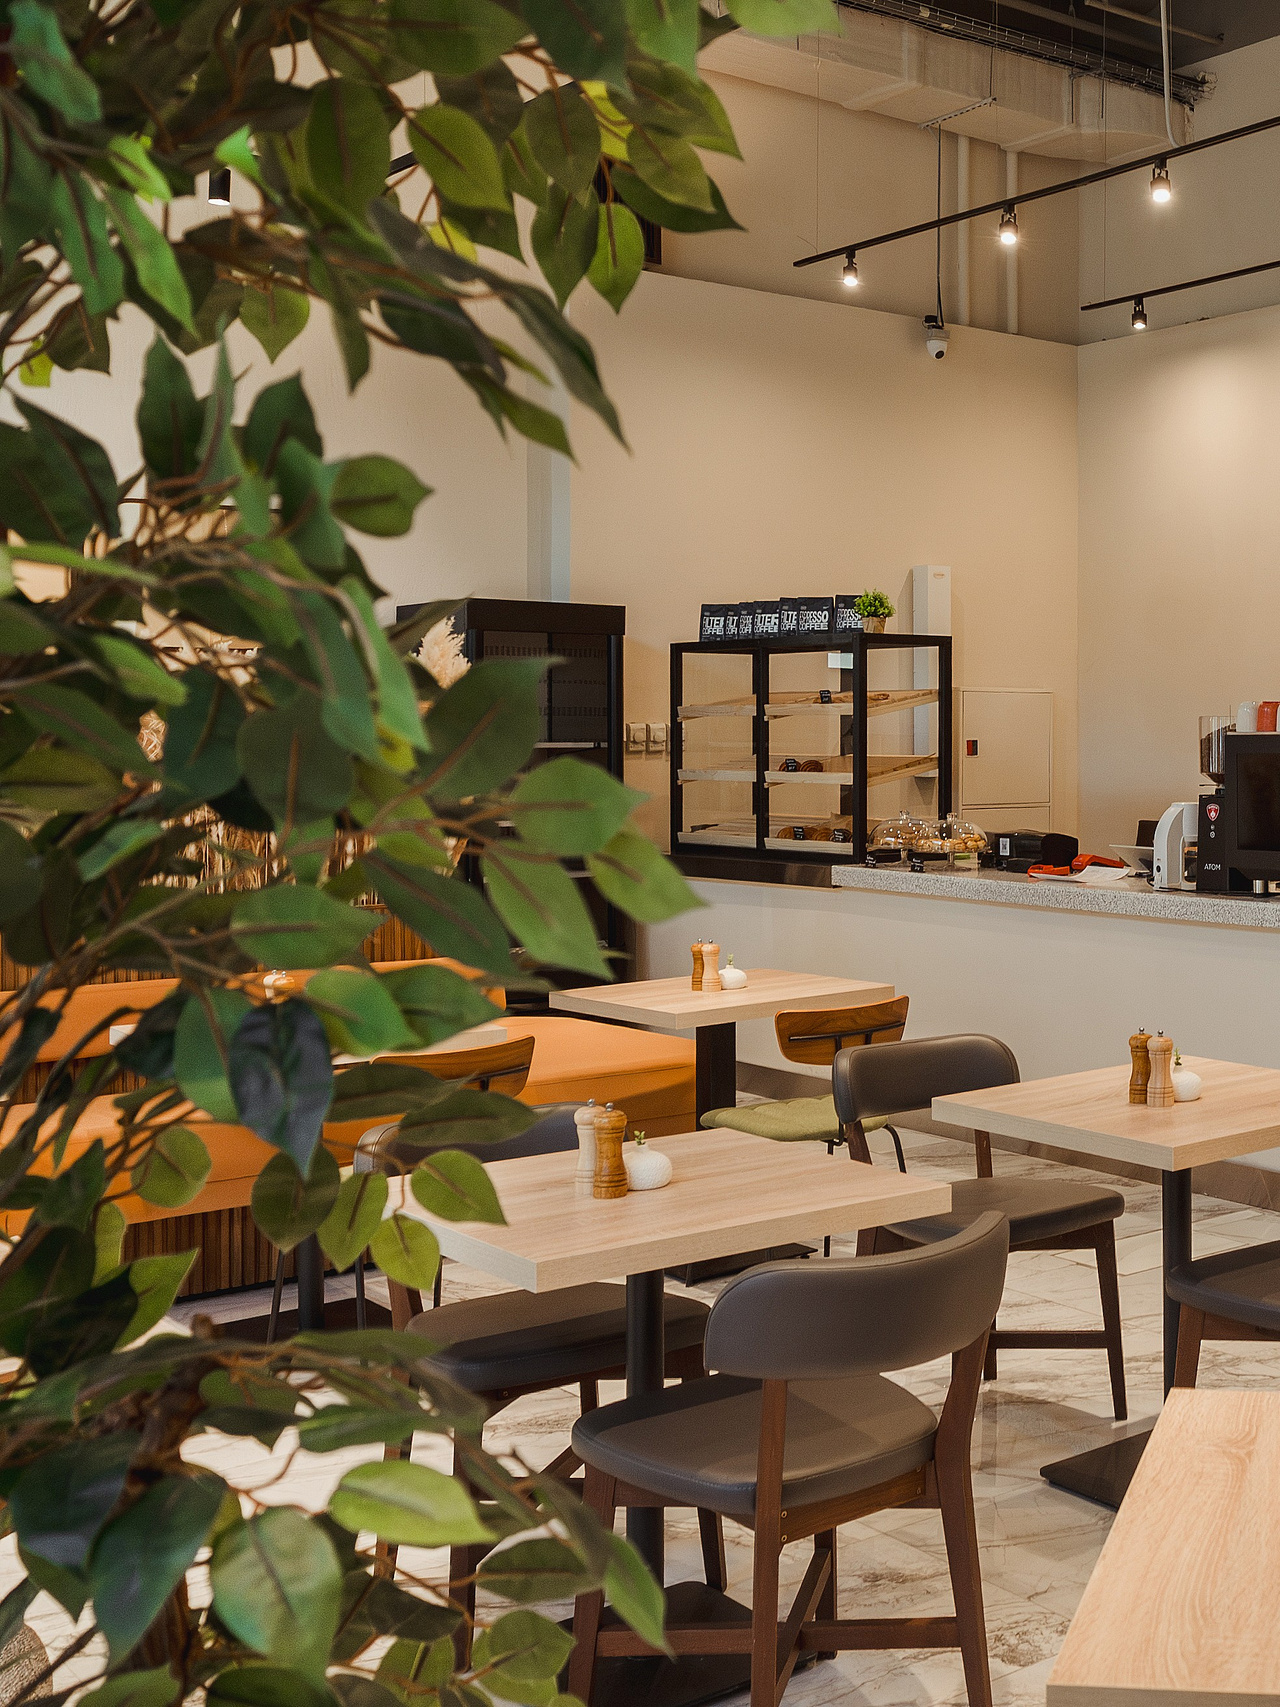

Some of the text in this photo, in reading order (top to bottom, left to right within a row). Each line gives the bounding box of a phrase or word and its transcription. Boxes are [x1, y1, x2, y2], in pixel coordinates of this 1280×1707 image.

[754, 613, 779, 626] FILTER
[799, 610, 829, 623] ESPRESSO
[798, 622, 829, 631] COFFEE
[1204, 863, 1221, 871] ATOM
